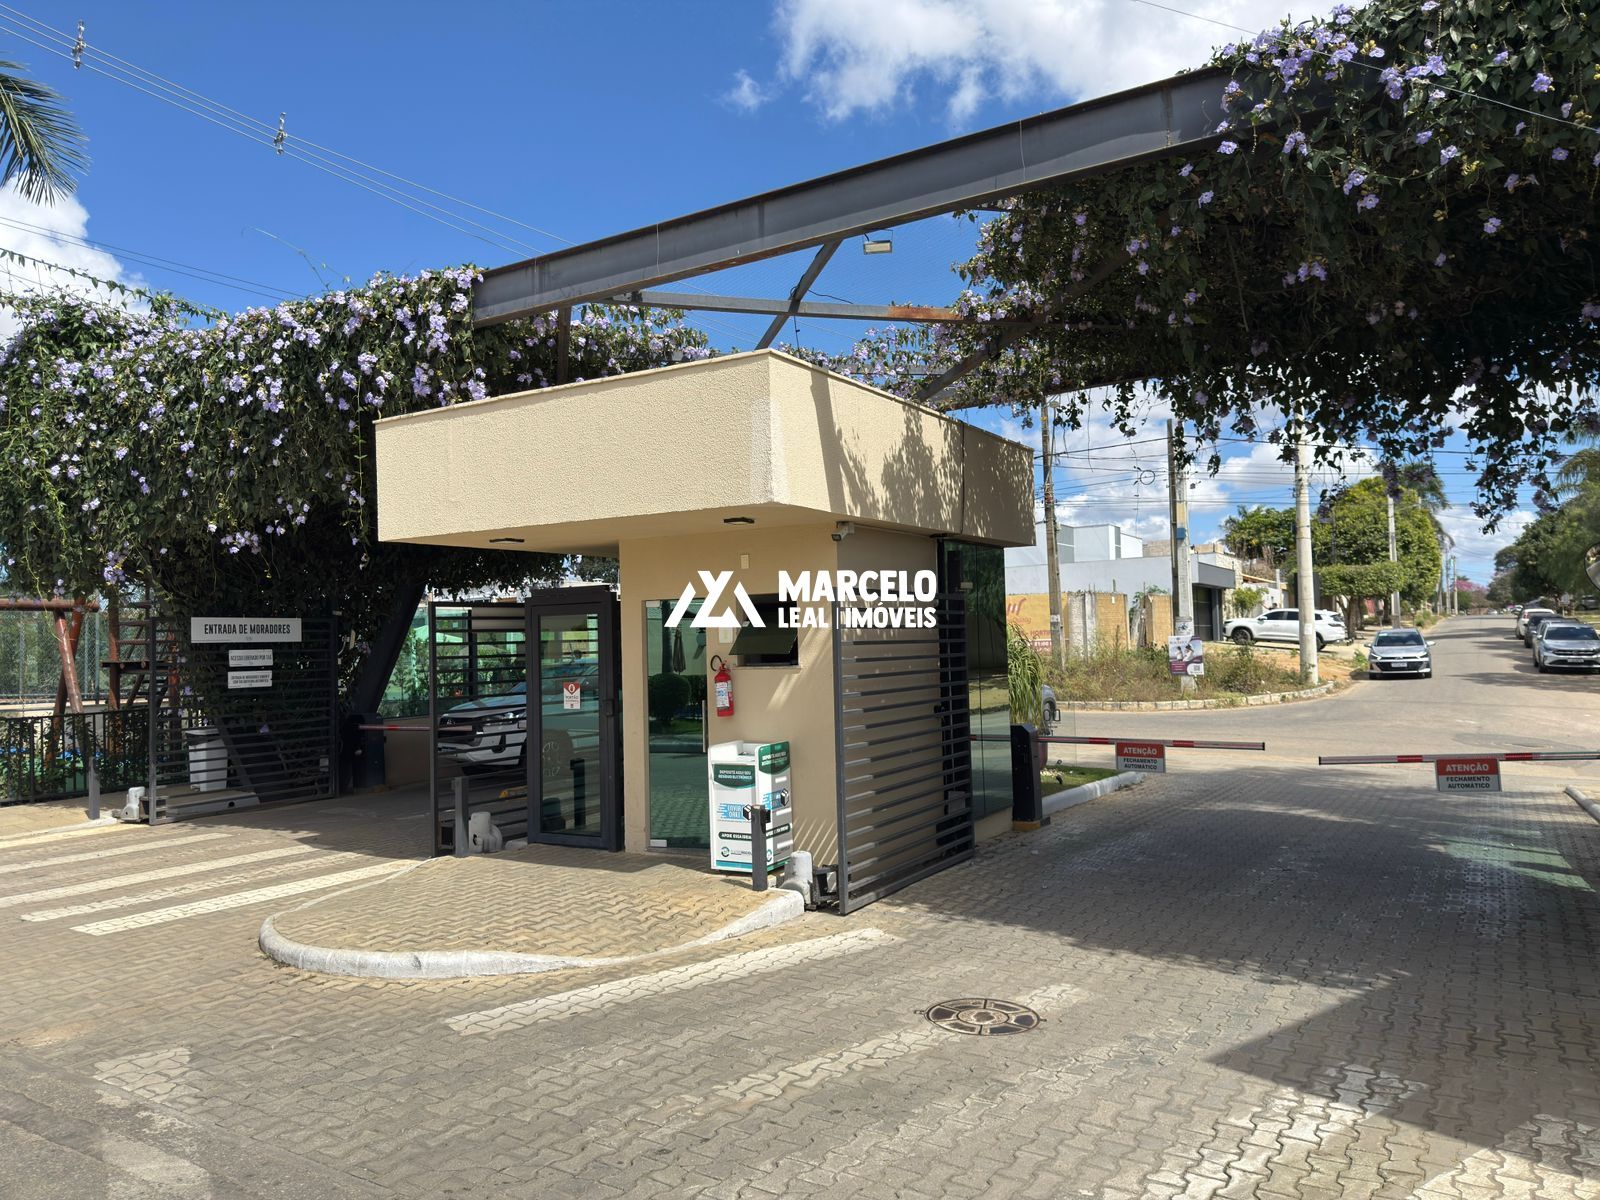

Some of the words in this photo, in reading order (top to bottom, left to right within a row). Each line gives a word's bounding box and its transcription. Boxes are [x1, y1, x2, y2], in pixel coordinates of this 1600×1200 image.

[204, 623, 237, 635] ENTRADA
[239, 623, 248, 635] DE
[249, 623, 291, 635] MORADORES
[1123, 746, 1158, 756] ATENÇÃO
[1446, 762, 1489, 774] ATENÇÃO
[1447, 781, 1490, 789] AUTOMÁTICO
